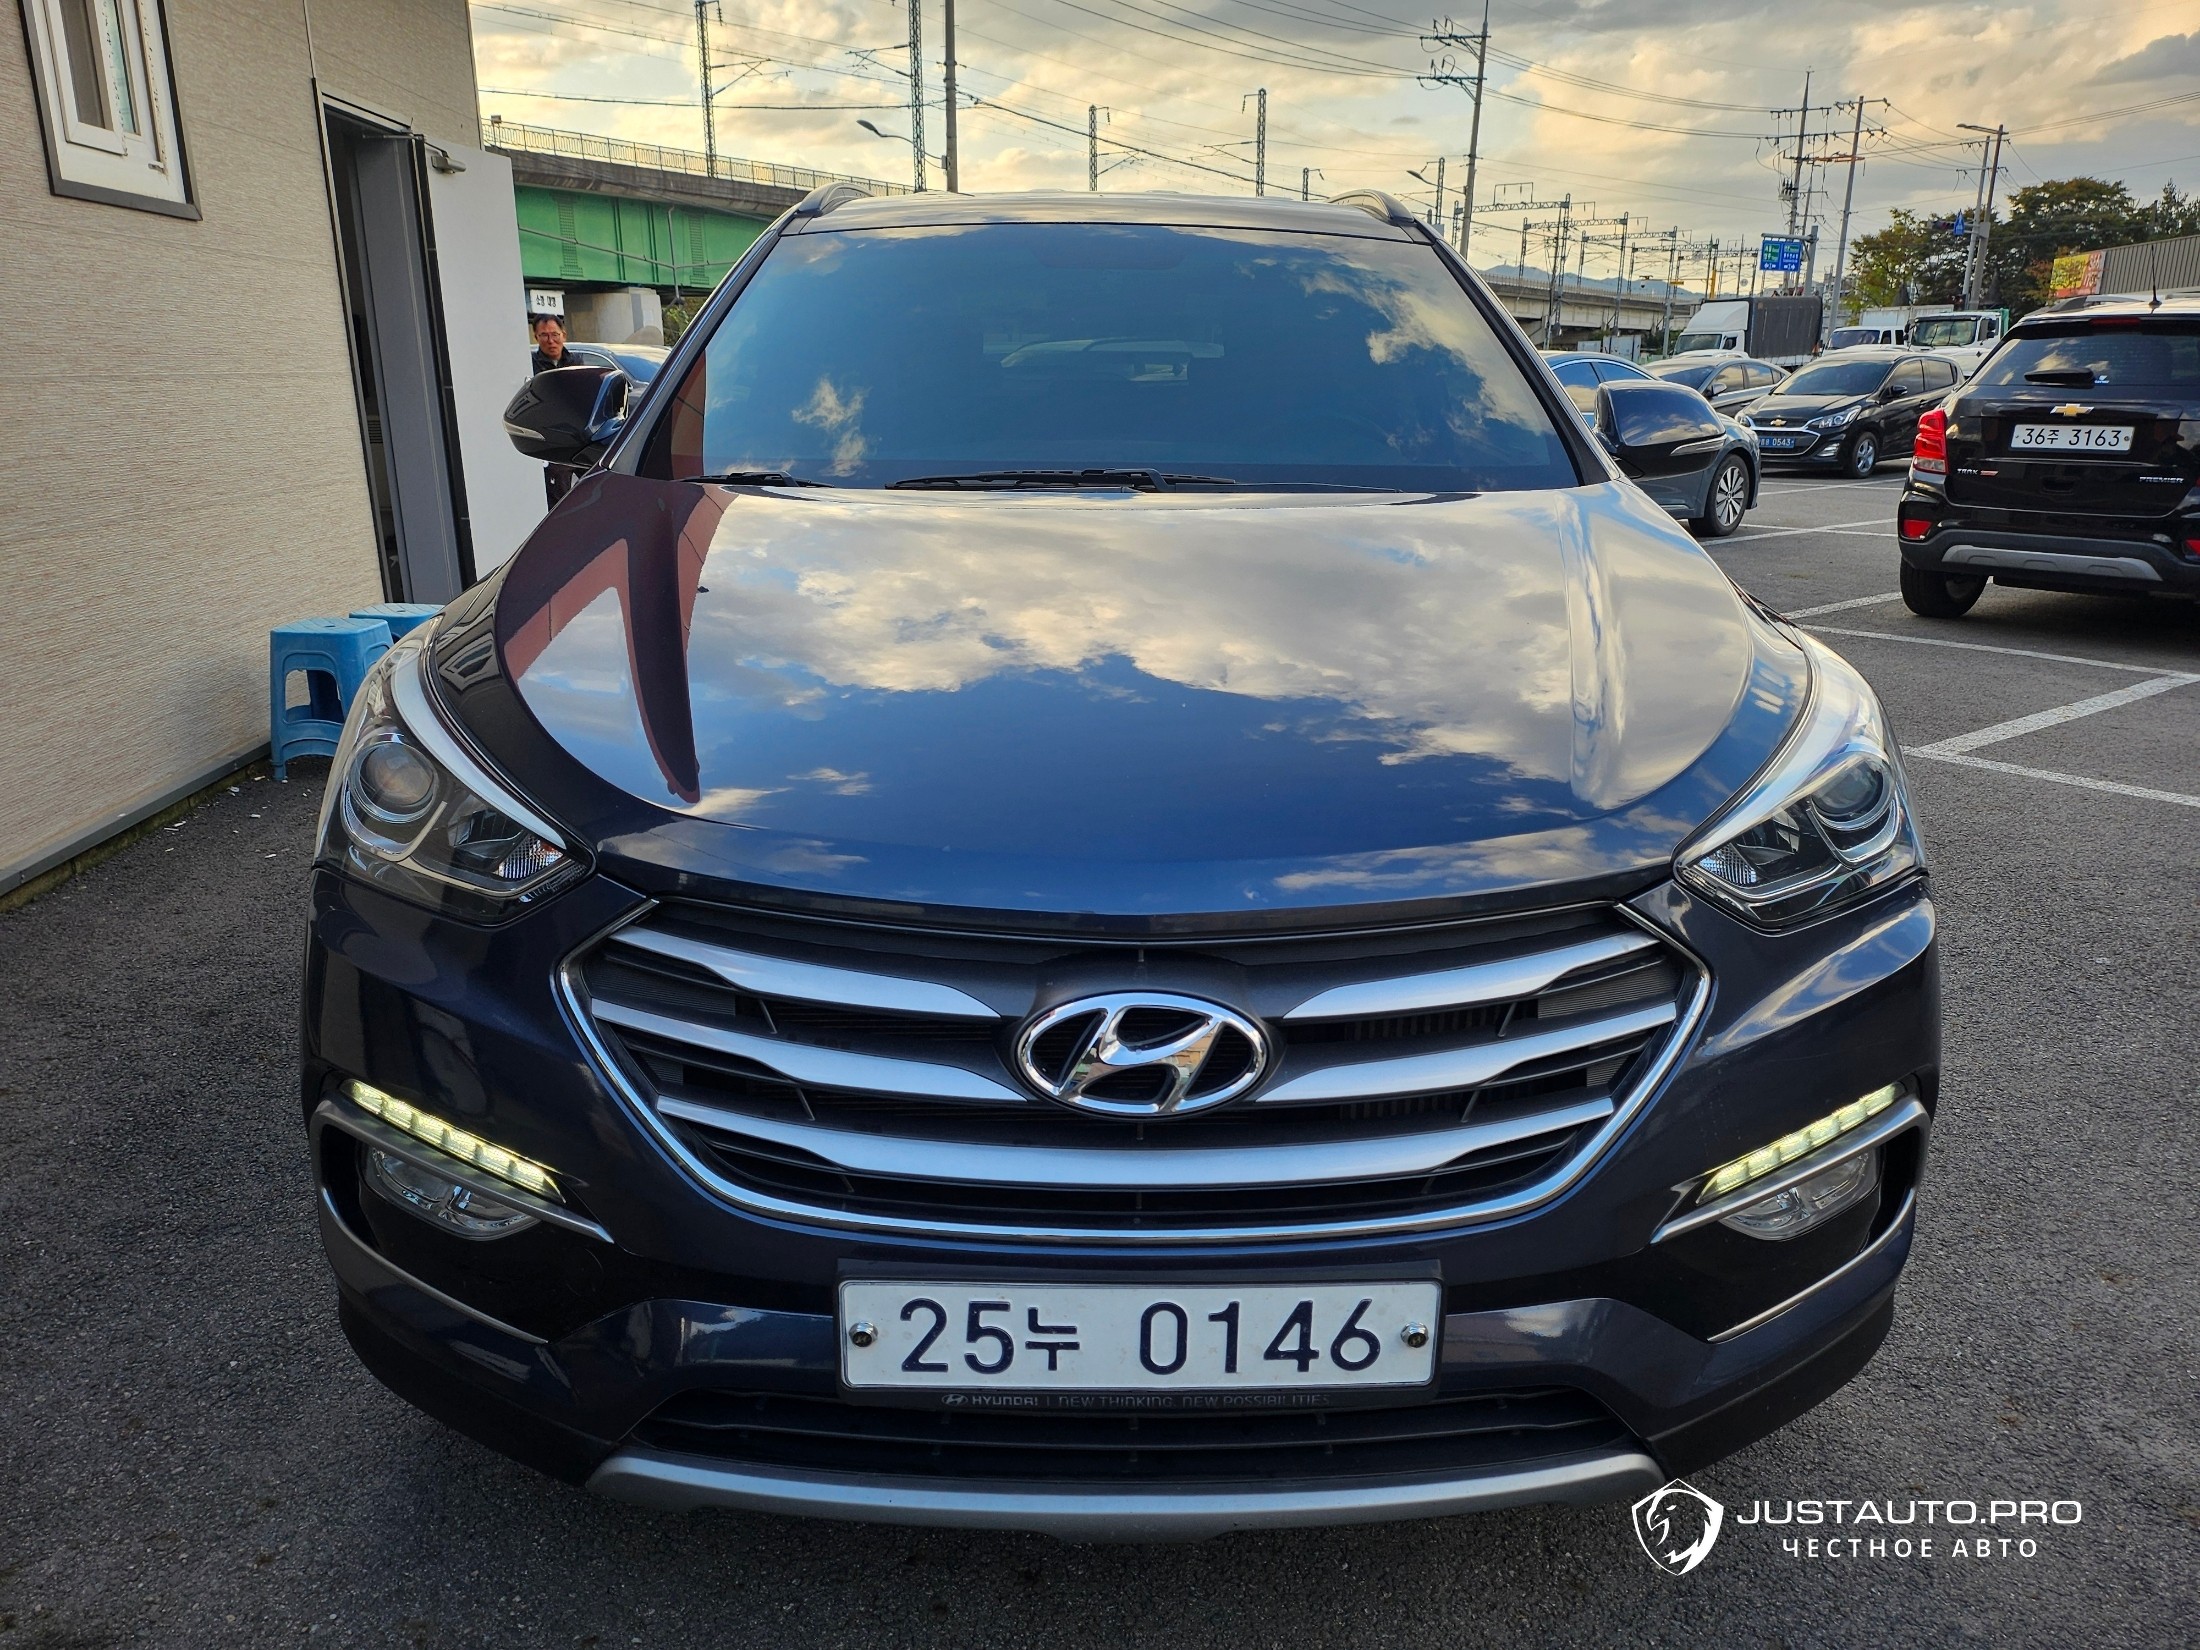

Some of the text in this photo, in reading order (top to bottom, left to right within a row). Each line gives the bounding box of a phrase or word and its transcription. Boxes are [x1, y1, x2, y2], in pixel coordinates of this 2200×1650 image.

[1772, 438, 1791, 446] 0543
[2022, 428, 2122, 447] 36주 3163
[900, 1298, 1381, 1375] 25누 0146
[972, 1395, 1038, 1406] HYUNDAI
[1058, 1395, 1095, 1408] NEW
[1182, 1396, 1219, 1408] NEW
